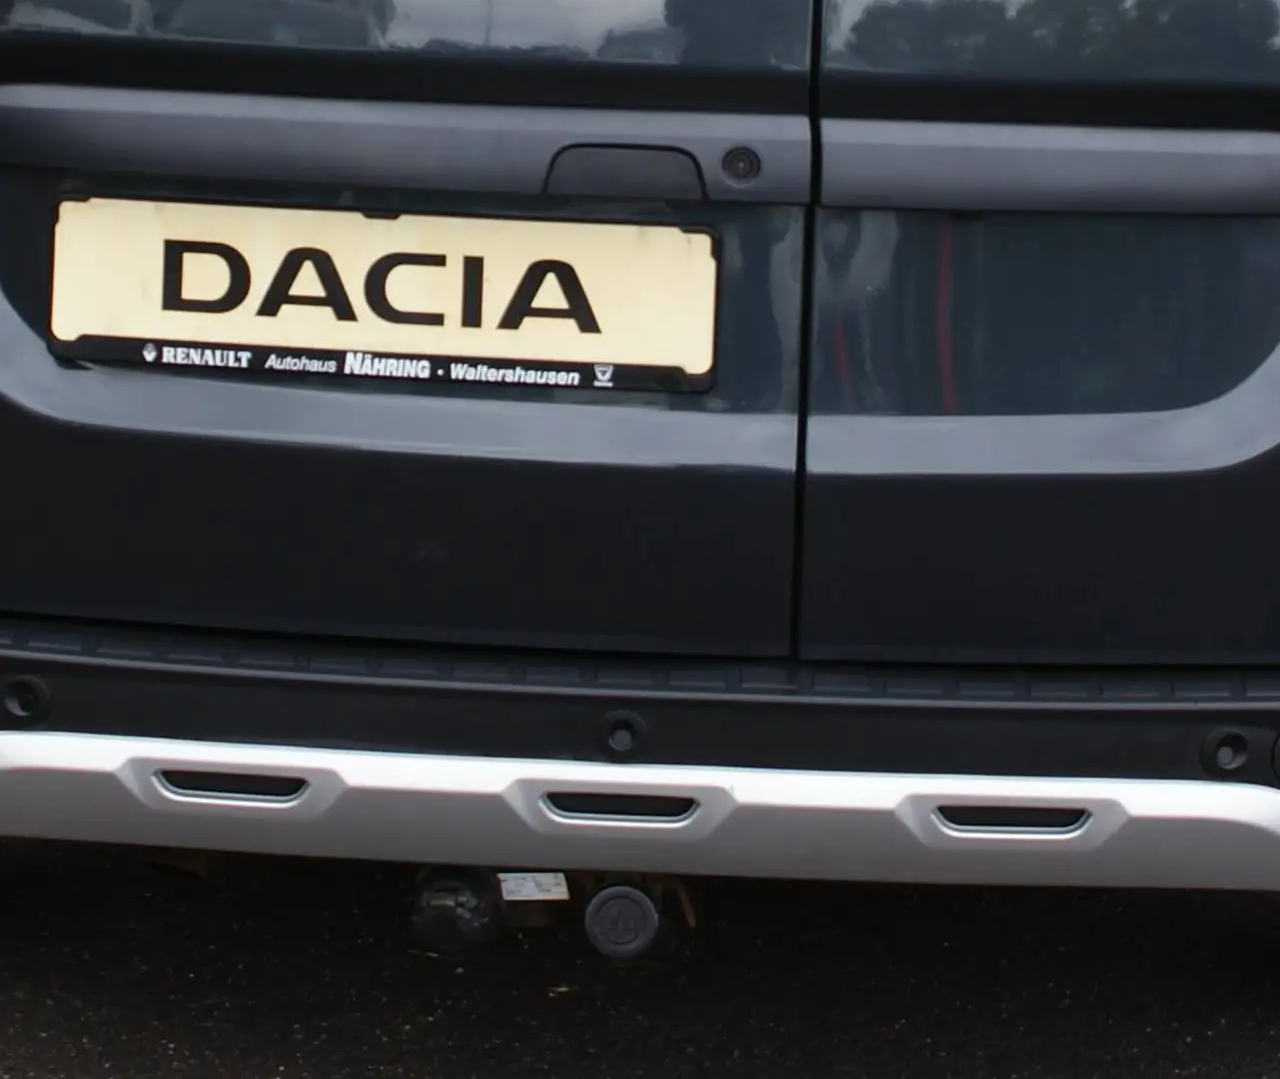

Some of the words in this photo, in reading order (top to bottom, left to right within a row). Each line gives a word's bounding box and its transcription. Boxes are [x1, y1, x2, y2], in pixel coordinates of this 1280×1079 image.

[160, 238, 602, 334] DACIA
[161, 346, 252, 368] RENAULT
[264, 353, 337, 373] Autohaus
[344, 351, 431, 379] NÄHRING
[450, 362, 581, 386] Waltershausen
